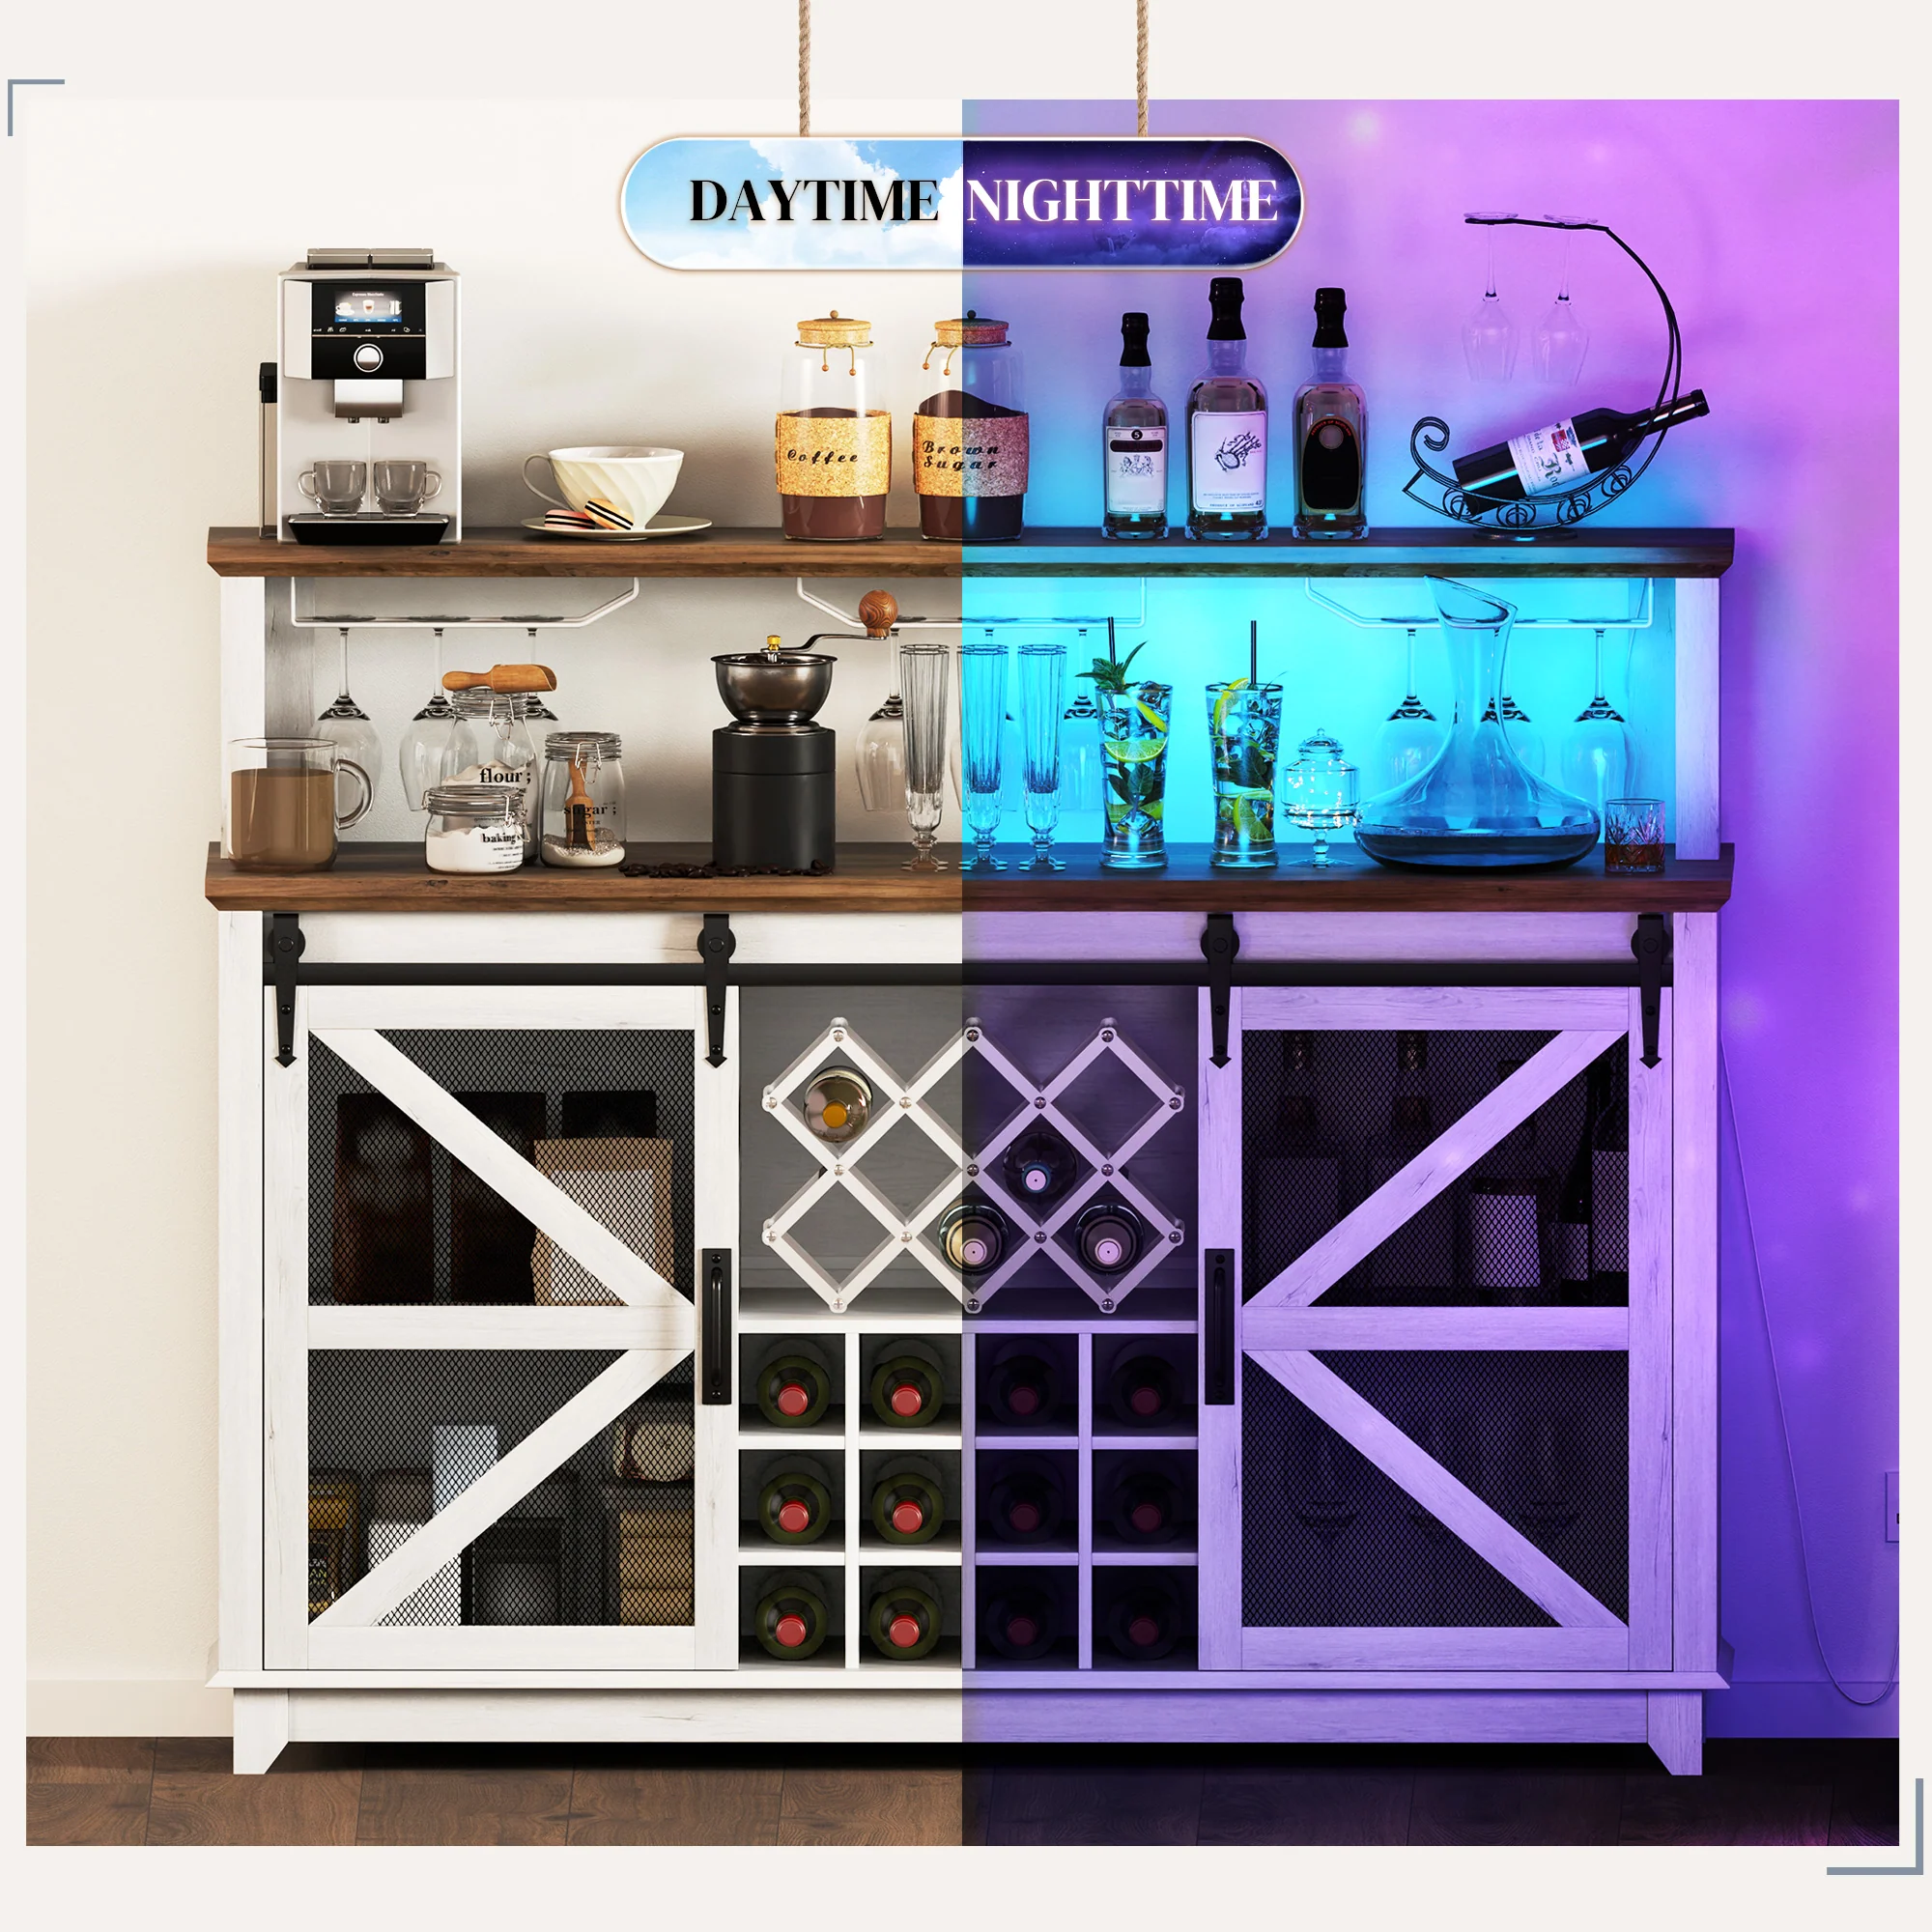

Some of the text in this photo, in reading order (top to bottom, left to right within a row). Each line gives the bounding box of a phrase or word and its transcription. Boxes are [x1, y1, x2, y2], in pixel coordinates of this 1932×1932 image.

[923, 440, 999, 455] Brown
[787, 448, 859, 465] Coffee
[923, 455, 998, 471] Sugar
[479, 767, 523, 783] flour
[482, 832, 517, 845] baking
